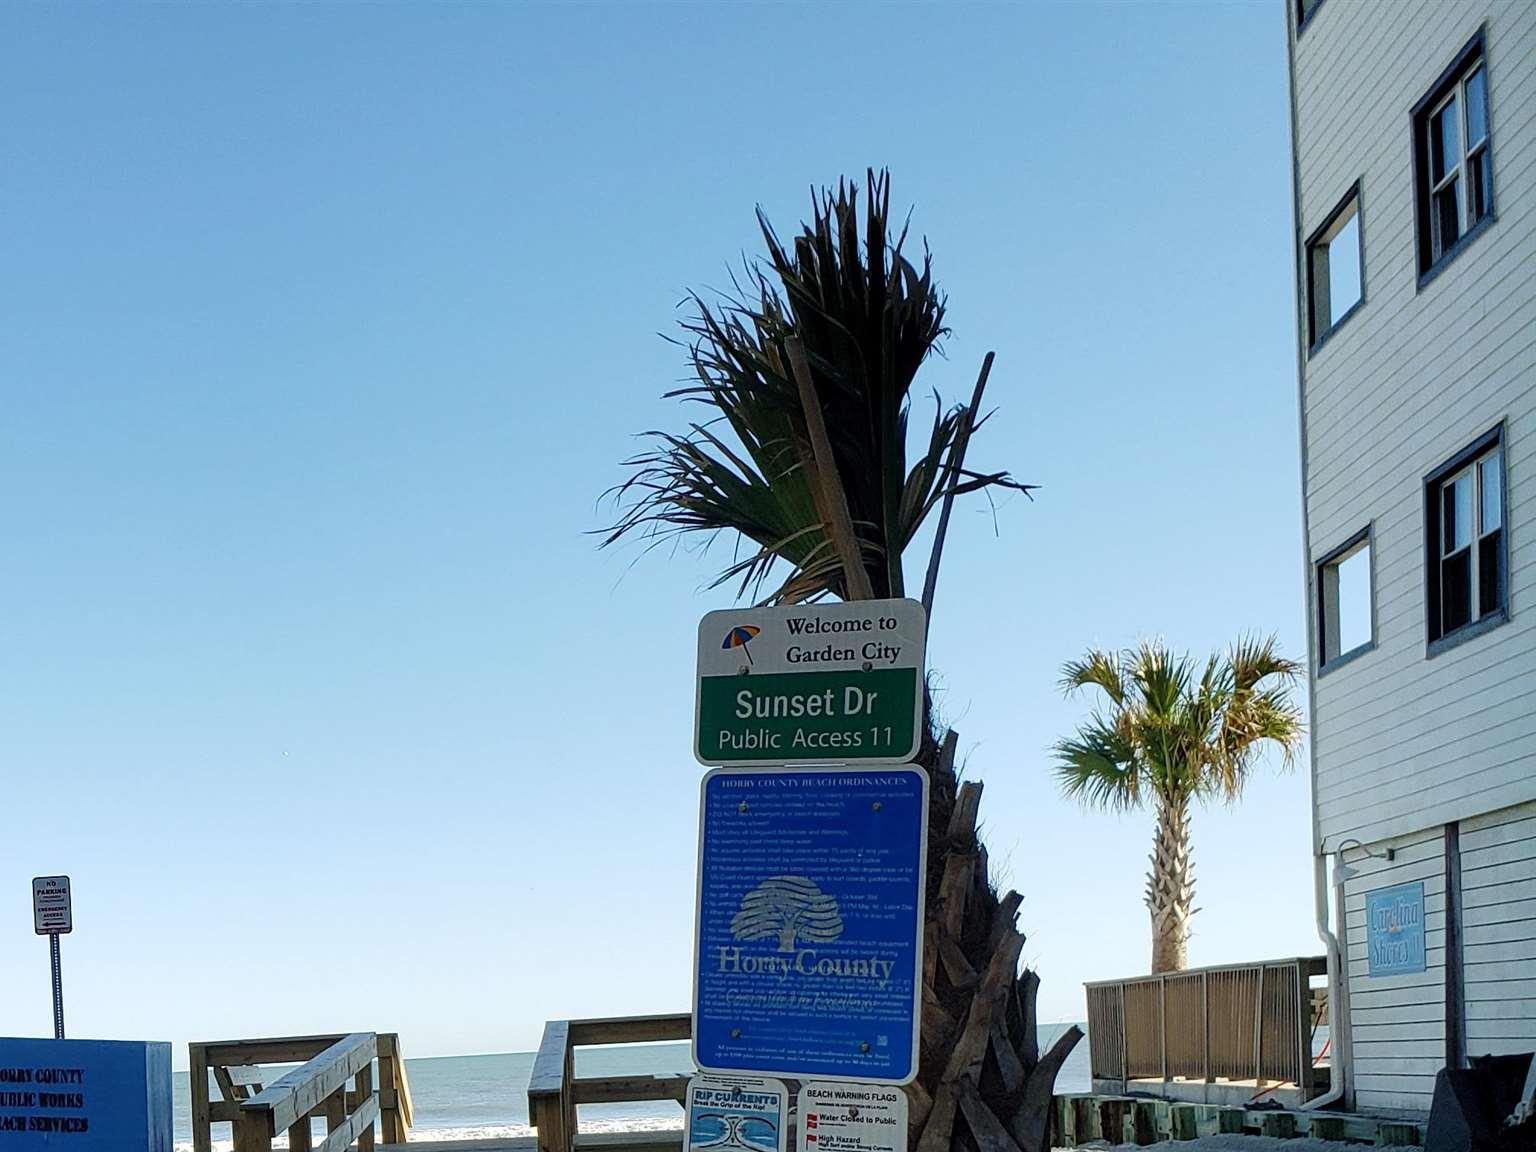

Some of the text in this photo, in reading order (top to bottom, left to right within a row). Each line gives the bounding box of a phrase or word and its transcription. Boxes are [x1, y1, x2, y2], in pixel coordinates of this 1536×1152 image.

[786, 616, 897, 636] Welcome to
[786, 641, 901, 664] Garden City
[735, 686, 878, 719] Sunset Dr
[719, 727, 892, 749] Public Access 11
[758, 779, 798, 787] COUNTY
[838, 777, 908, 786] ORDINANCES
[37, 888, 66, 896] PARKING
[1370, 896, 1419, 932] Carolina
[717, 946, 896, 991] Horry County
[35, 1068, 84, 1083] COUNTY
[38, 1093, 83, 1108] WORKS
[695, 1090, 713, 1100] RIP
[807, 1090, 897, 1102] BEACH WARNING FLAGS
[720, 1100, 734, 1108] Grip
[29, 1116, 89, 1132] SERVICES
[819, 1113, 839, 1121] Water
[840, 1115, 864, 1123] Closed
[875, 1117, 897, 1125] Public
[818, 1134, 861, 1144] High Hazard
